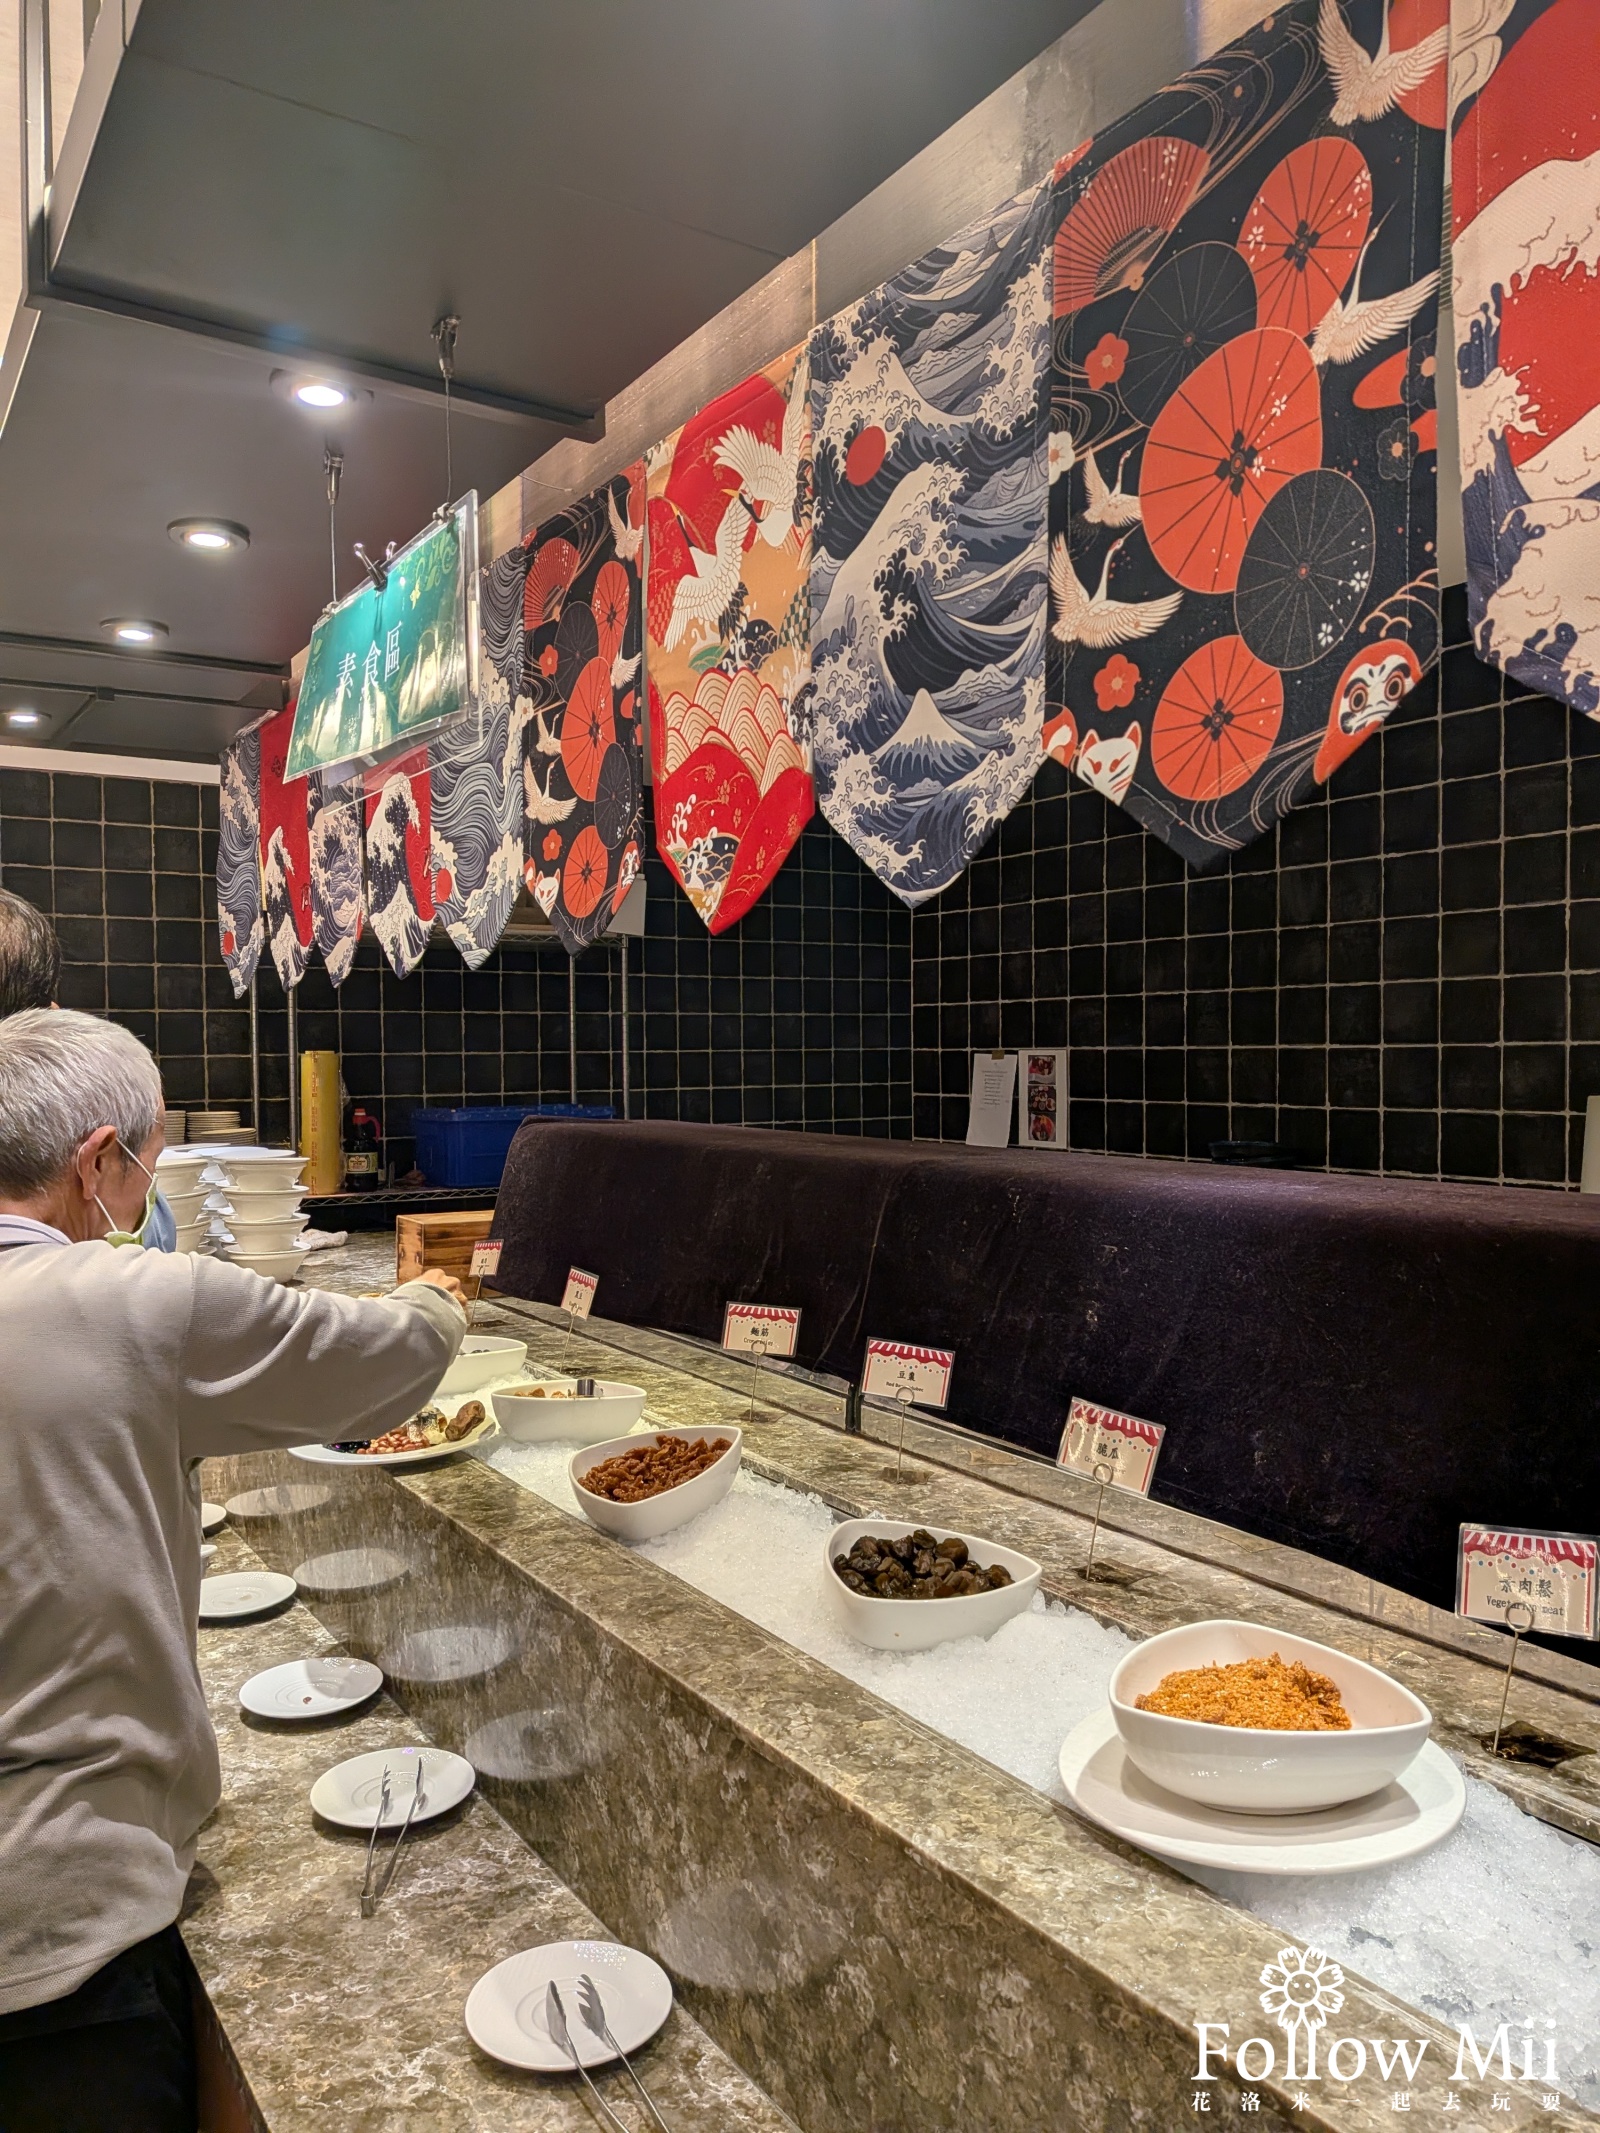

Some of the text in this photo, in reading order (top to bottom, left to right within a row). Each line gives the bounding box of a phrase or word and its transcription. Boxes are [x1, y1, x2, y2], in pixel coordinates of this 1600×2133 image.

[336, 620, 402, 699] 素食區
[1096, 1443, 1119, 1460] 脆瓜
[1542, 1605, 1564, 1616] meat
